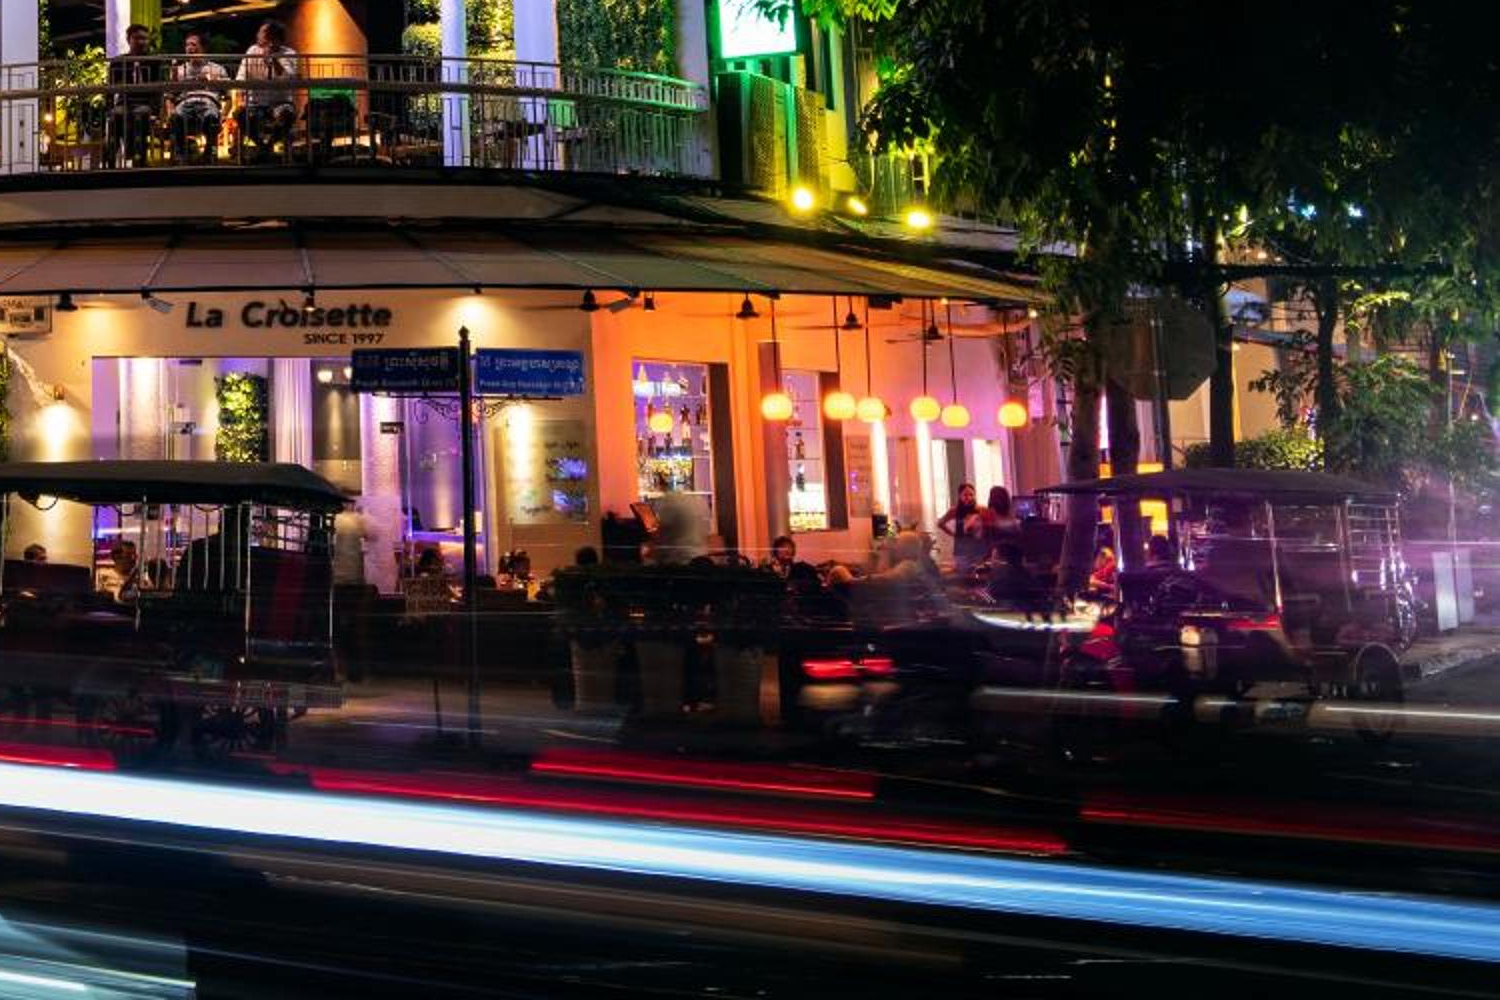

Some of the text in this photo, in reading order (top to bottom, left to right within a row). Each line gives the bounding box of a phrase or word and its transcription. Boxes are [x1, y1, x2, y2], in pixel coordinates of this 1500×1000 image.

[186, 301, 223, 328] La
[304, 333, 385, 345] SINCE 1997
